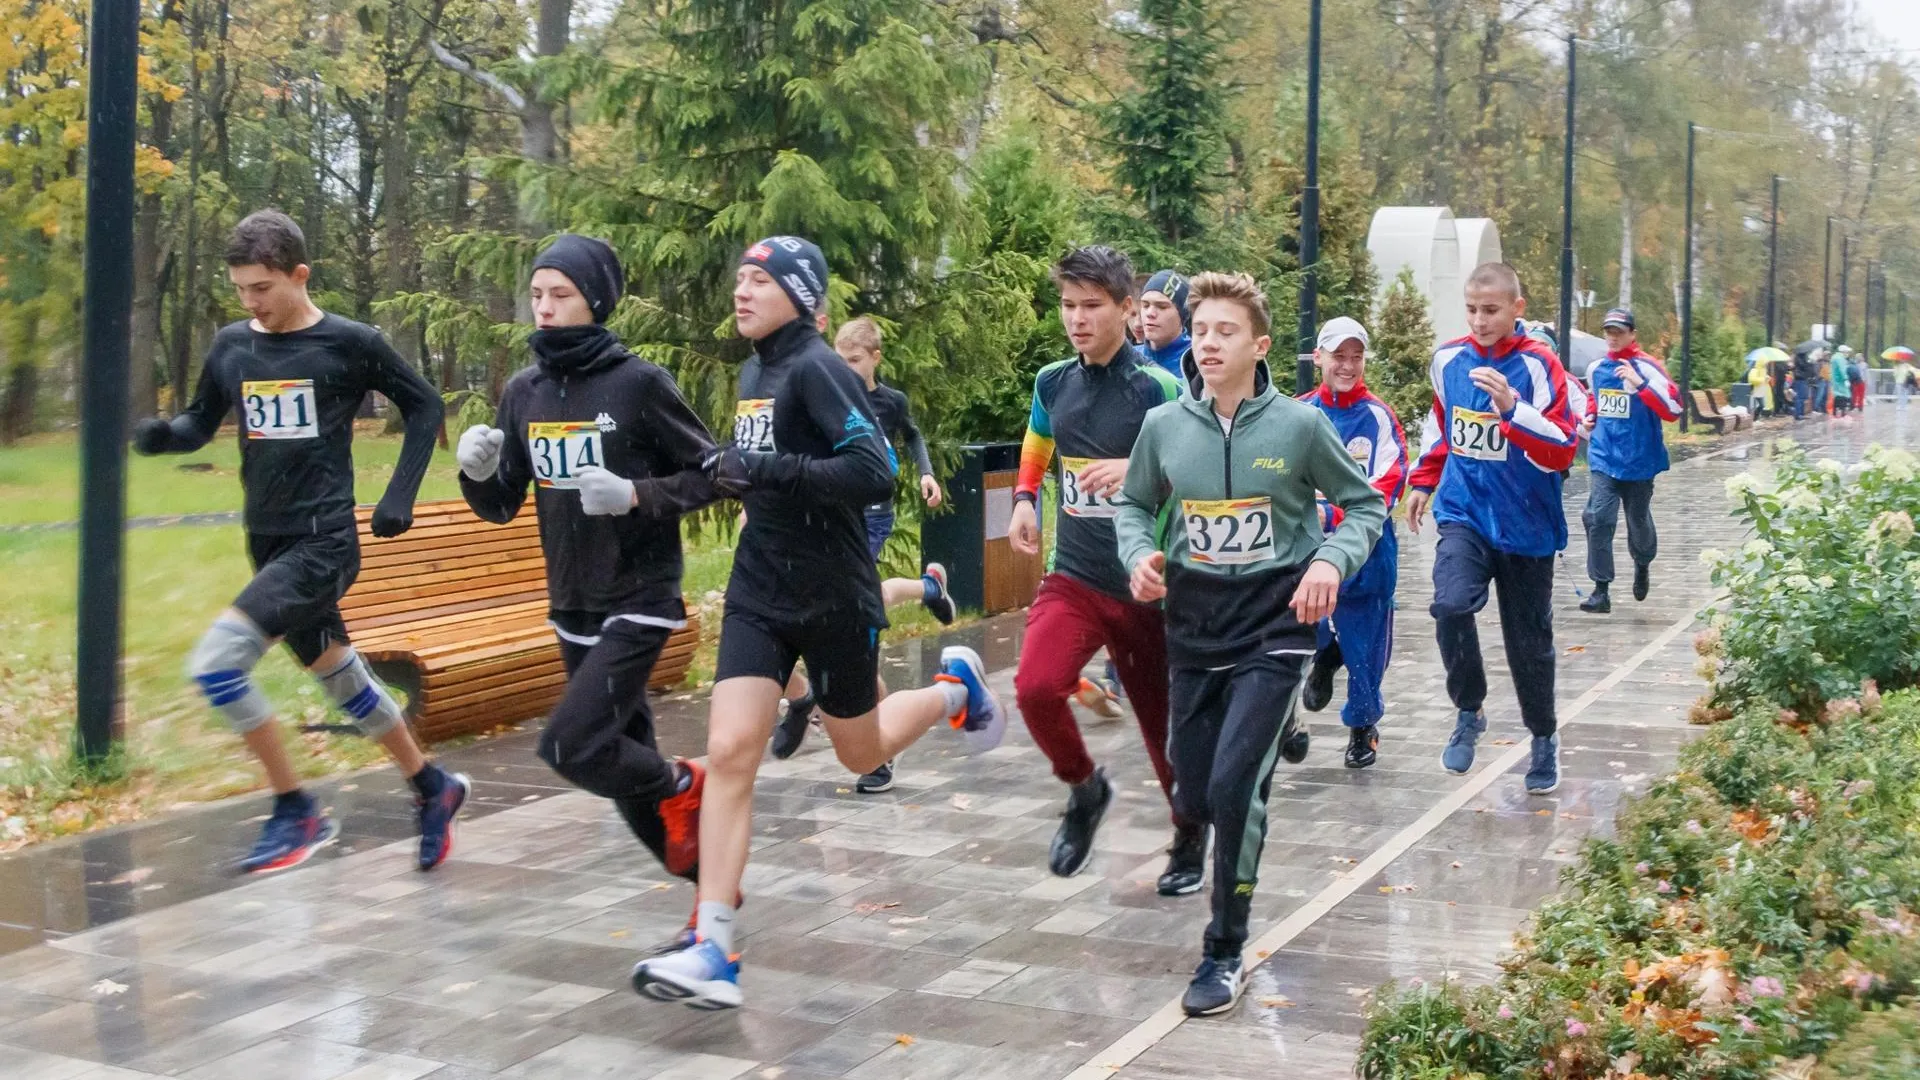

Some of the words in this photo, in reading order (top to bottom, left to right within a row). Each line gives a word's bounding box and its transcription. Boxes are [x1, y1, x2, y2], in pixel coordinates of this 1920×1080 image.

[247, 393, 311, 428] 311
[1600, 393, 1628, 414] 299
[1453, 417, 1506, 452] 320
[534, 436, 599, 478] 314
[1252, 457, 1285, 469] FILA
[1188, 511, 1272, 553] 322
